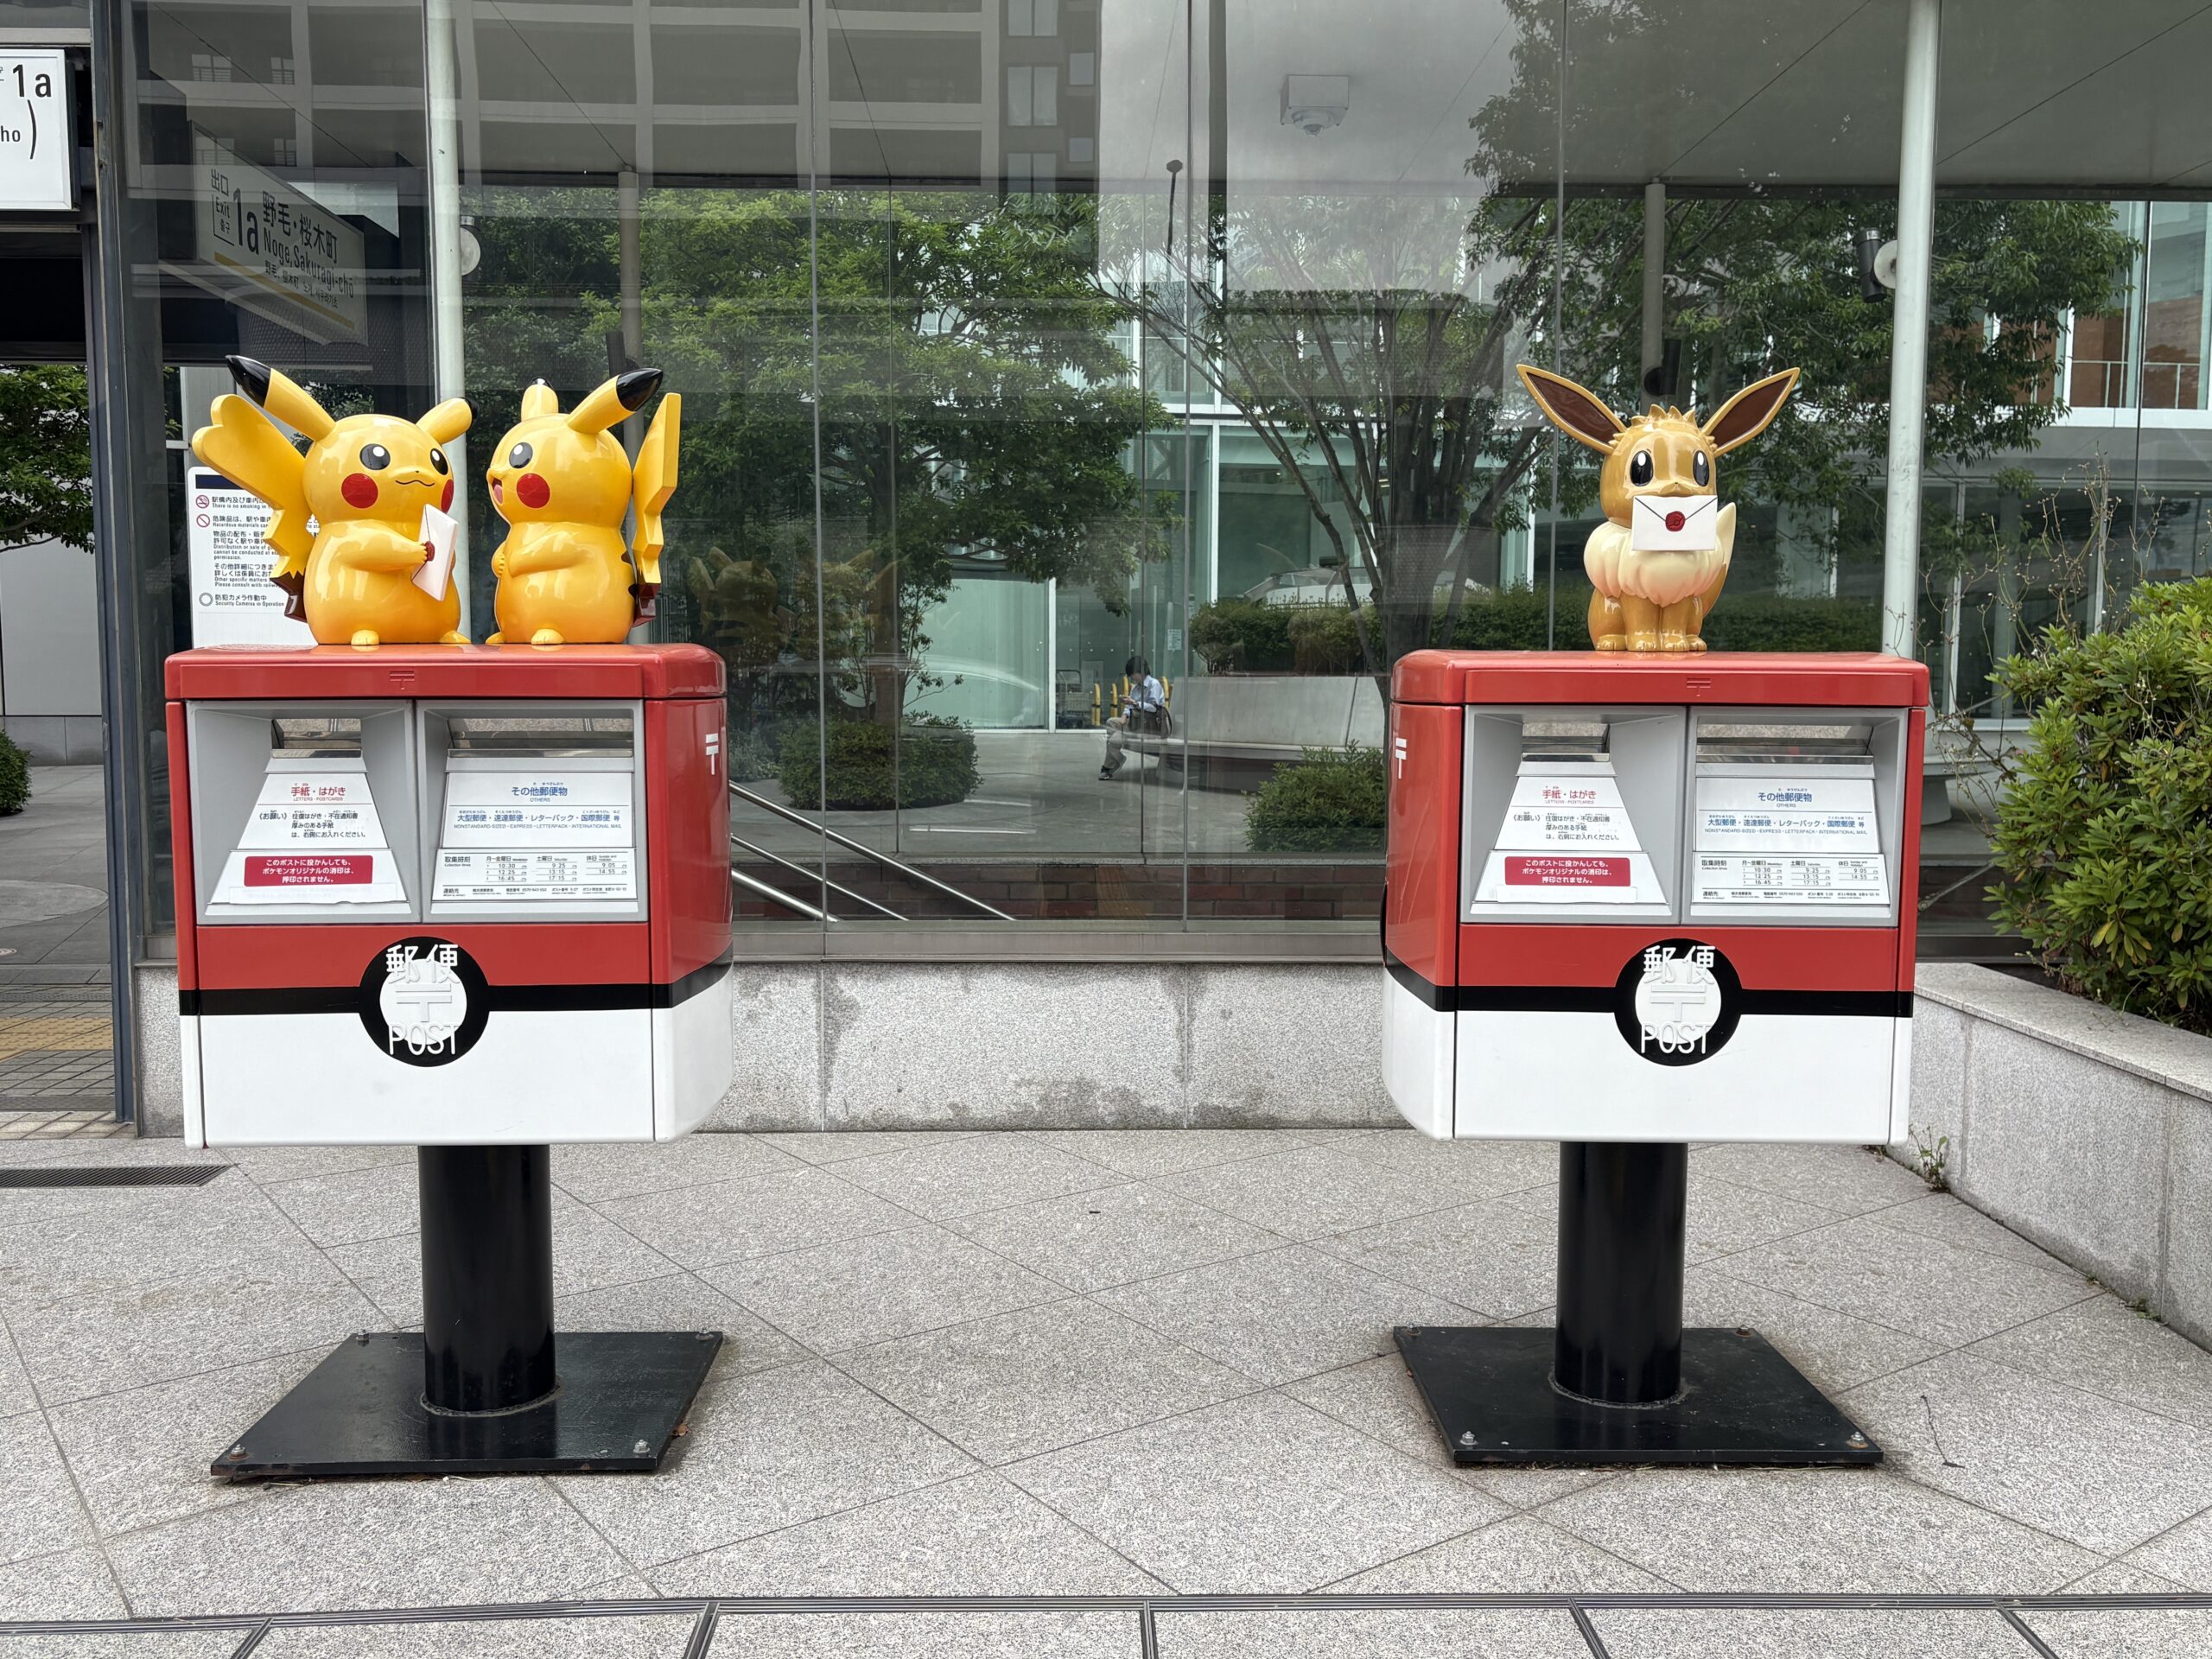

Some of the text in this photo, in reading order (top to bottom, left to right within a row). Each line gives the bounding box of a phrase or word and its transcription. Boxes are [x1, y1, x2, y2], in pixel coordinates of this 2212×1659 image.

[13, 64, 51, 98] 1a
[211, 168, 229, 196] 出口
[216, 197, 230, 218] Exit
[233, 188, 259, 255] 1a
[263, 190, 338, 264] 野毛・桜木町
[291, 786, 346, 796] 手紙・はがき
[511, 786, 568, 797] その他郵便物
[1542, 790, 1596, 799] 手紙・はがき
[1758, 792, 1812, 802] その他郵便物
[385, 944, 460, 984] 郵便
[1643, 945, 1715, 985] 郵便
[388, 1022, 460, 1056] POST
[1641, 1021, 1713, 1054] POST
